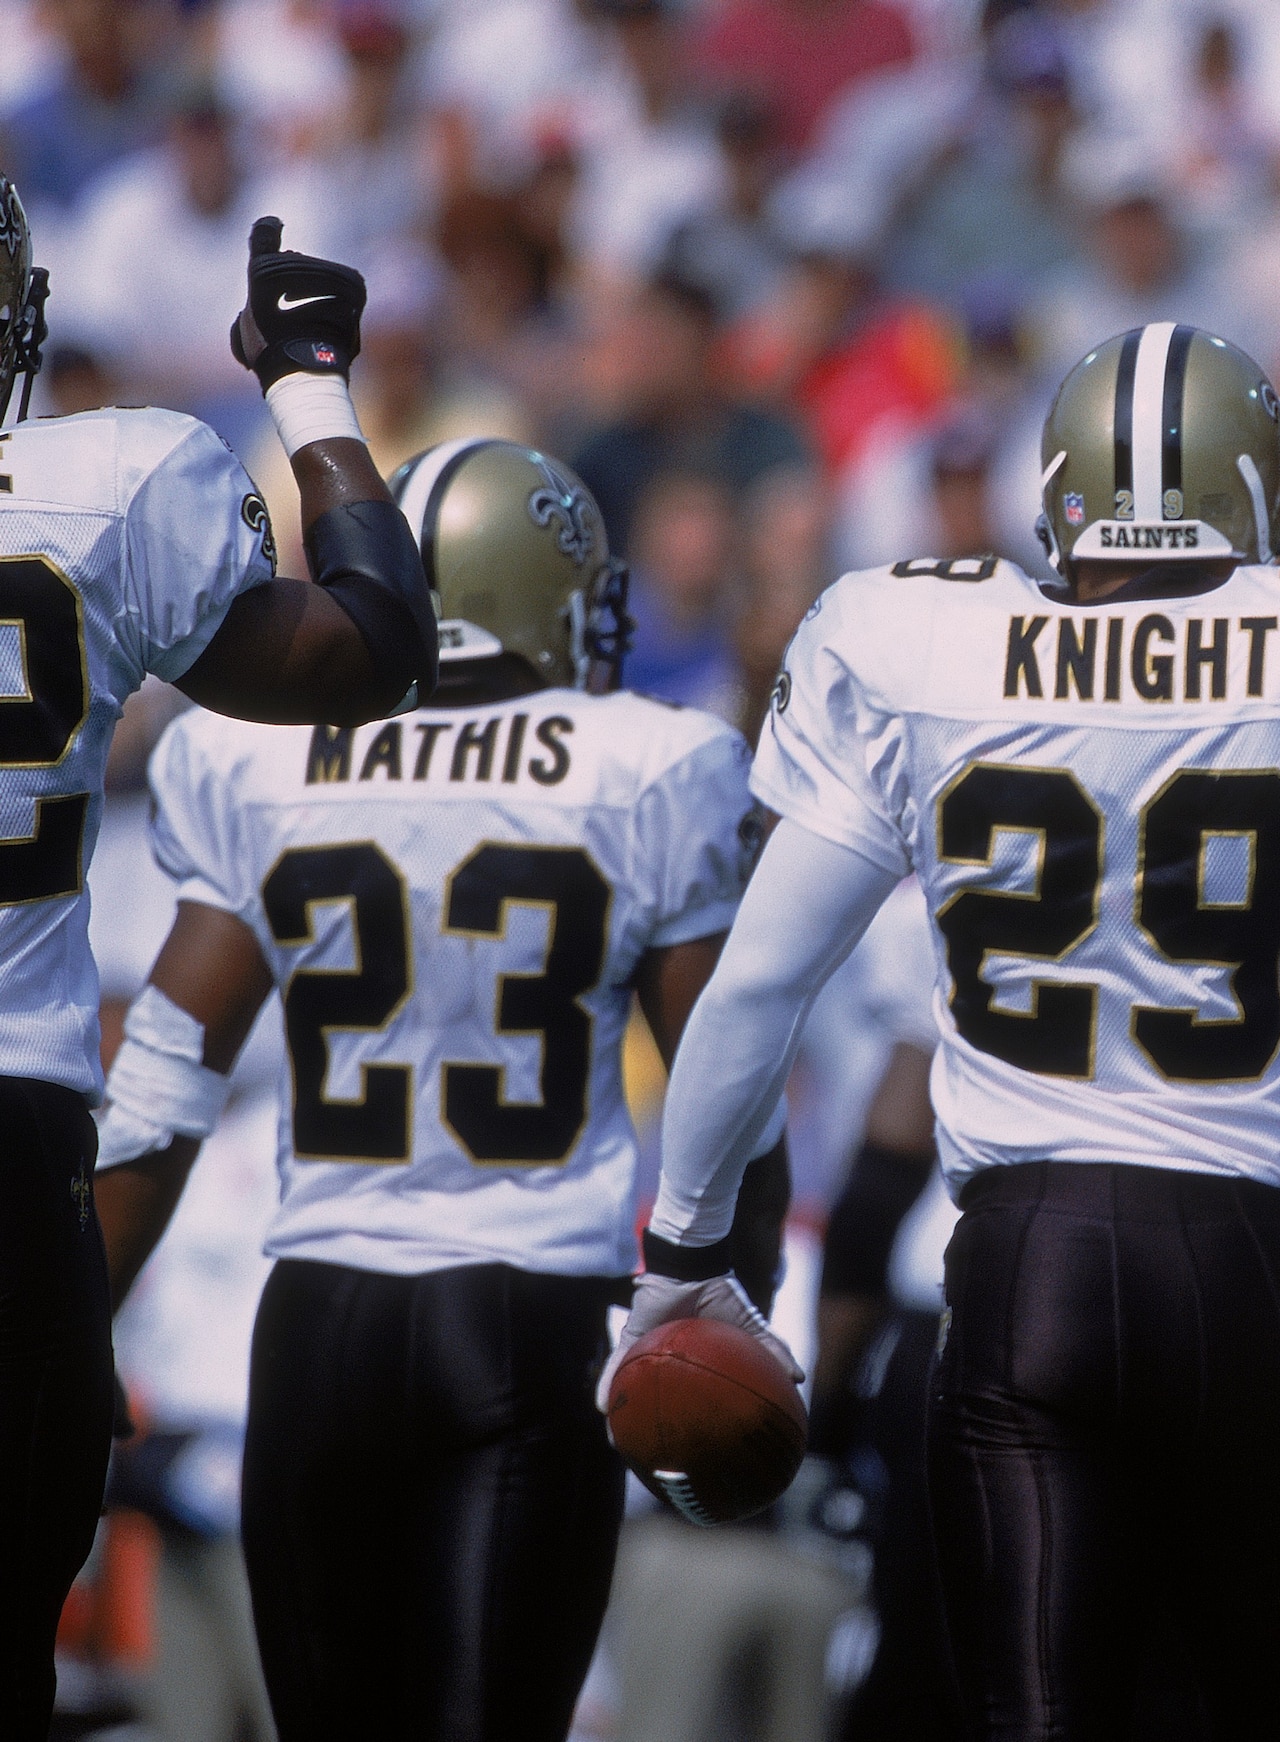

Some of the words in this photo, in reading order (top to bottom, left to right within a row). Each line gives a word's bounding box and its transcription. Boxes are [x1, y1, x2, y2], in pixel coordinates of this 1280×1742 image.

[1100, 526, 1198, 548] SAINTS
[1002, 613, 1279, 703] KNIGHT
[304, 713, 577, 787] MATHIS
[260, 839, 614, 1168] 23
